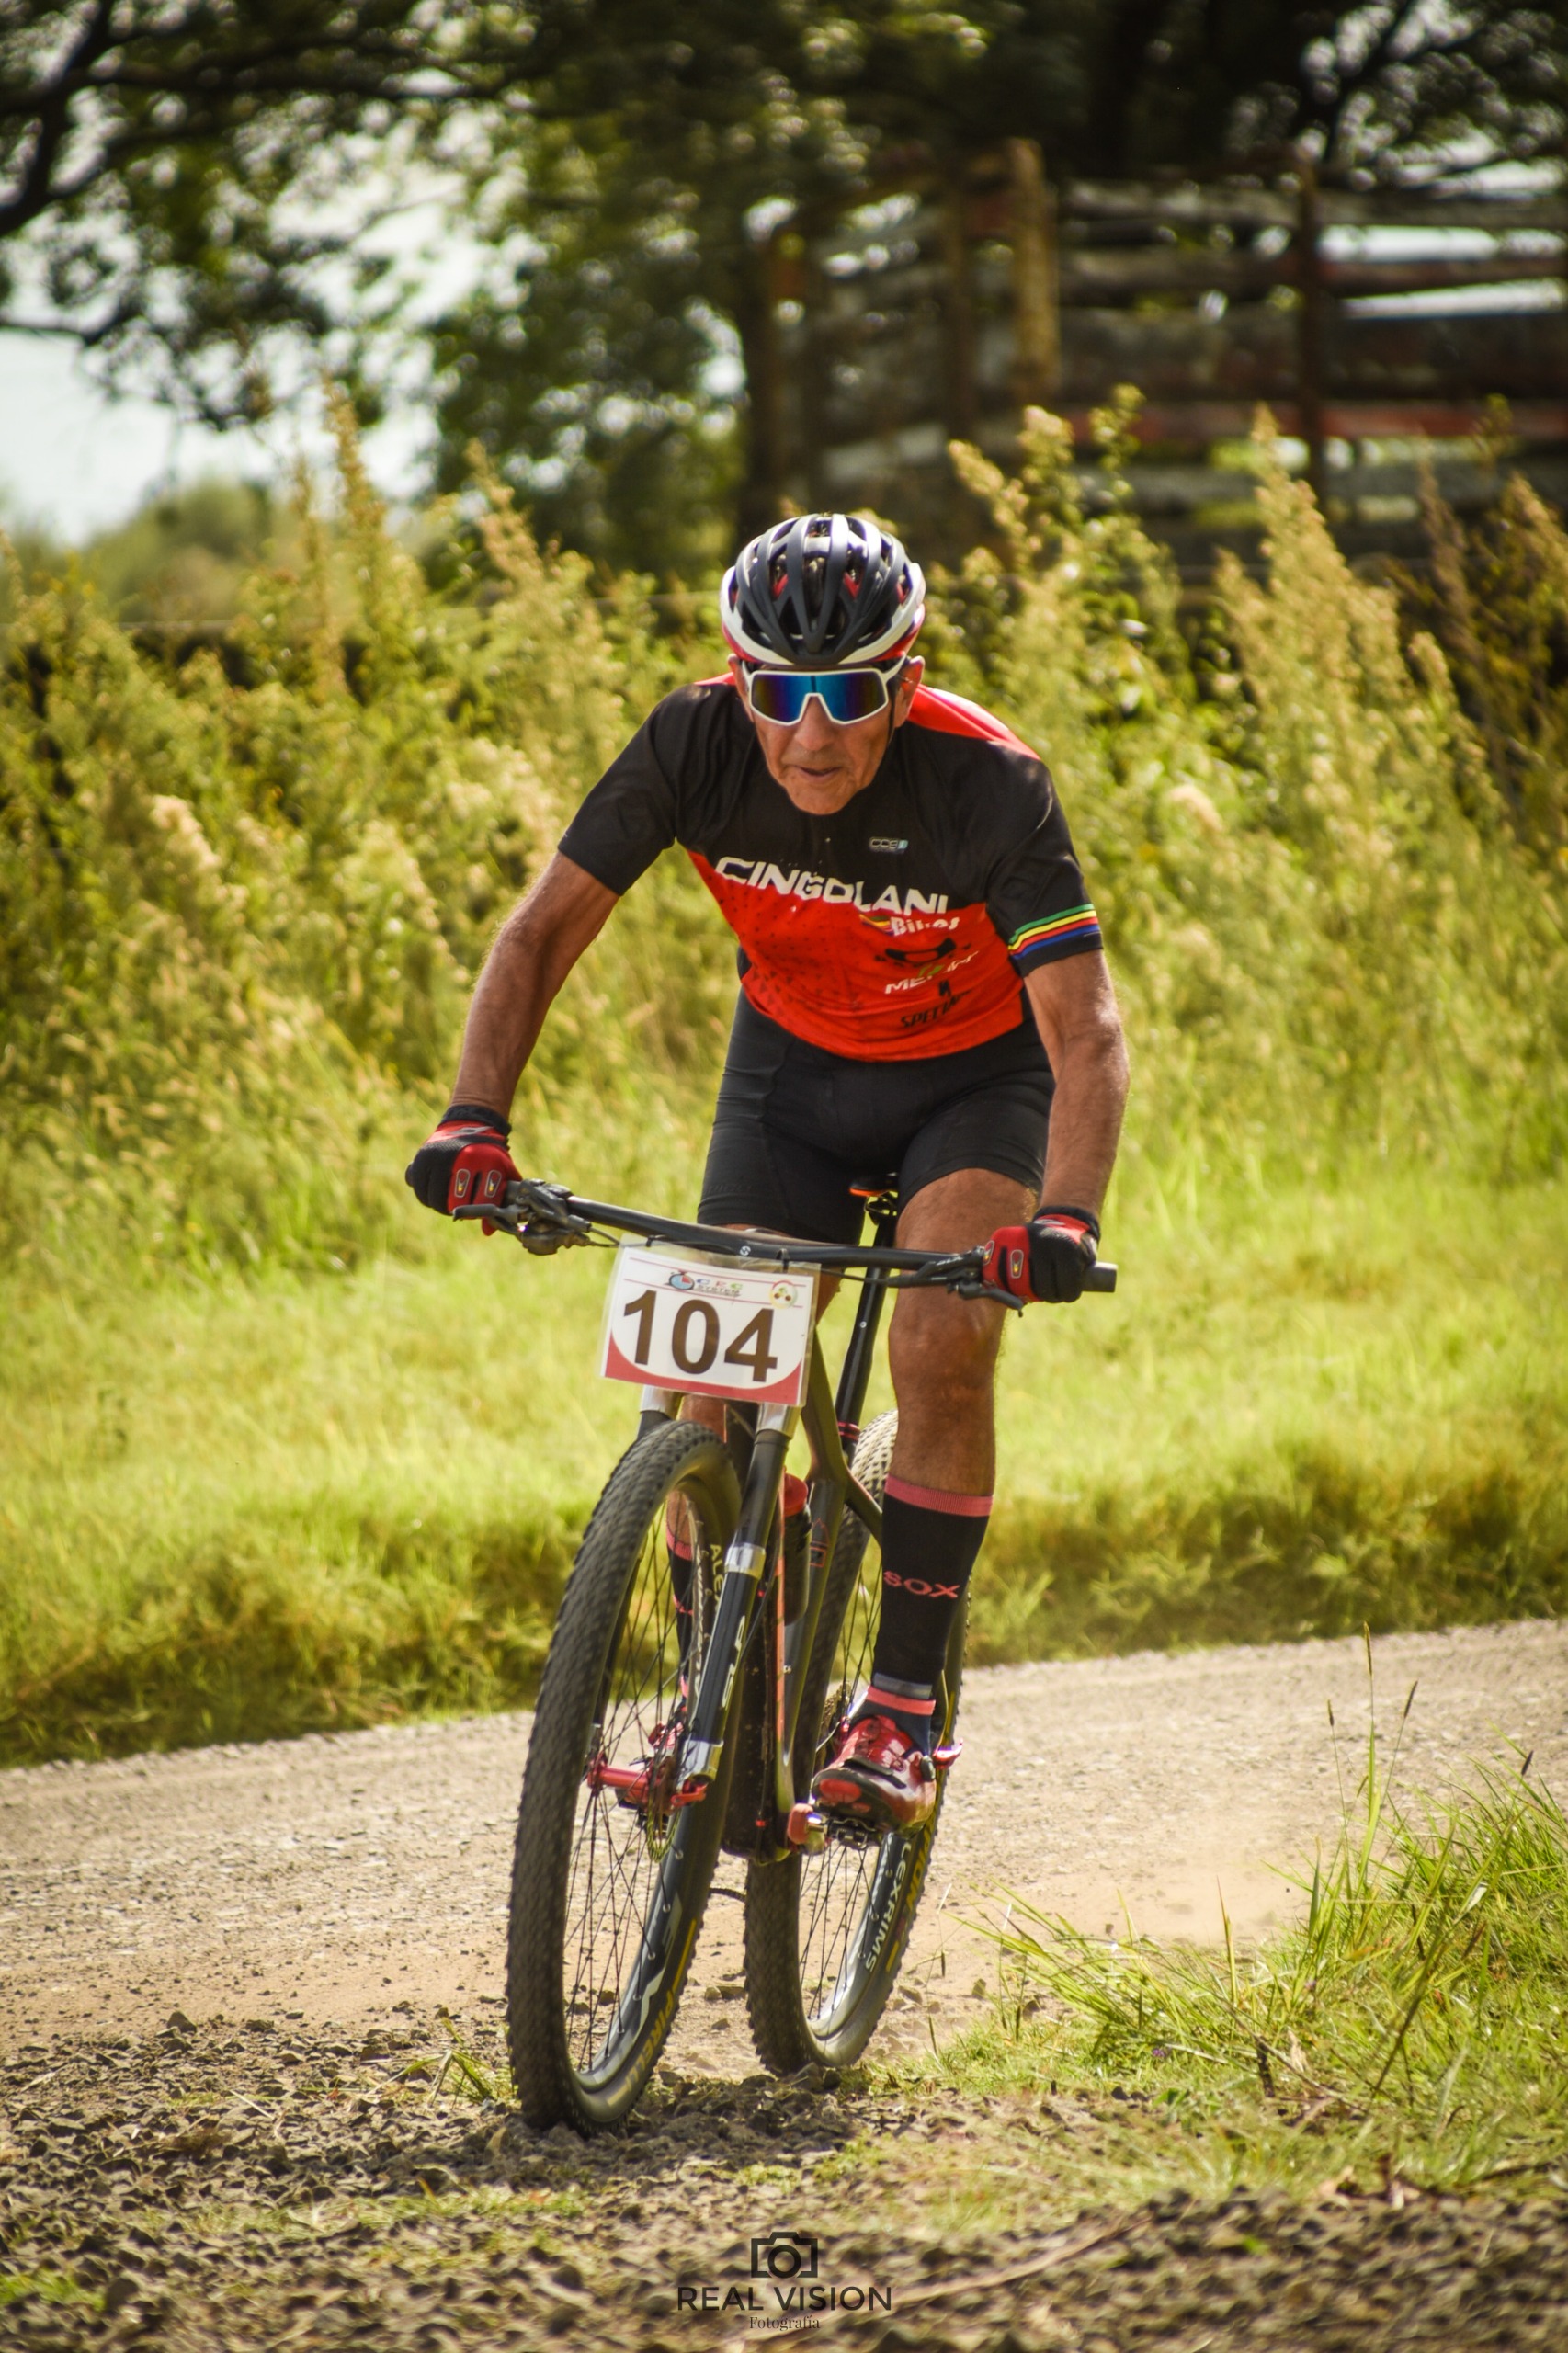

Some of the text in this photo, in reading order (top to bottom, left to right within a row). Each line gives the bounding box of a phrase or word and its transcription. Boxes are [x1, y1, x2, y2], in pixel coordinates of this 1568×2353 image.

[714, 856, 949, 917] CINGOLANI
[623, 1290, 778, 1383] 104
[883, 1570, 960, 1598] SOX
[865, 1841, 913, 1973] LEXRIMS
